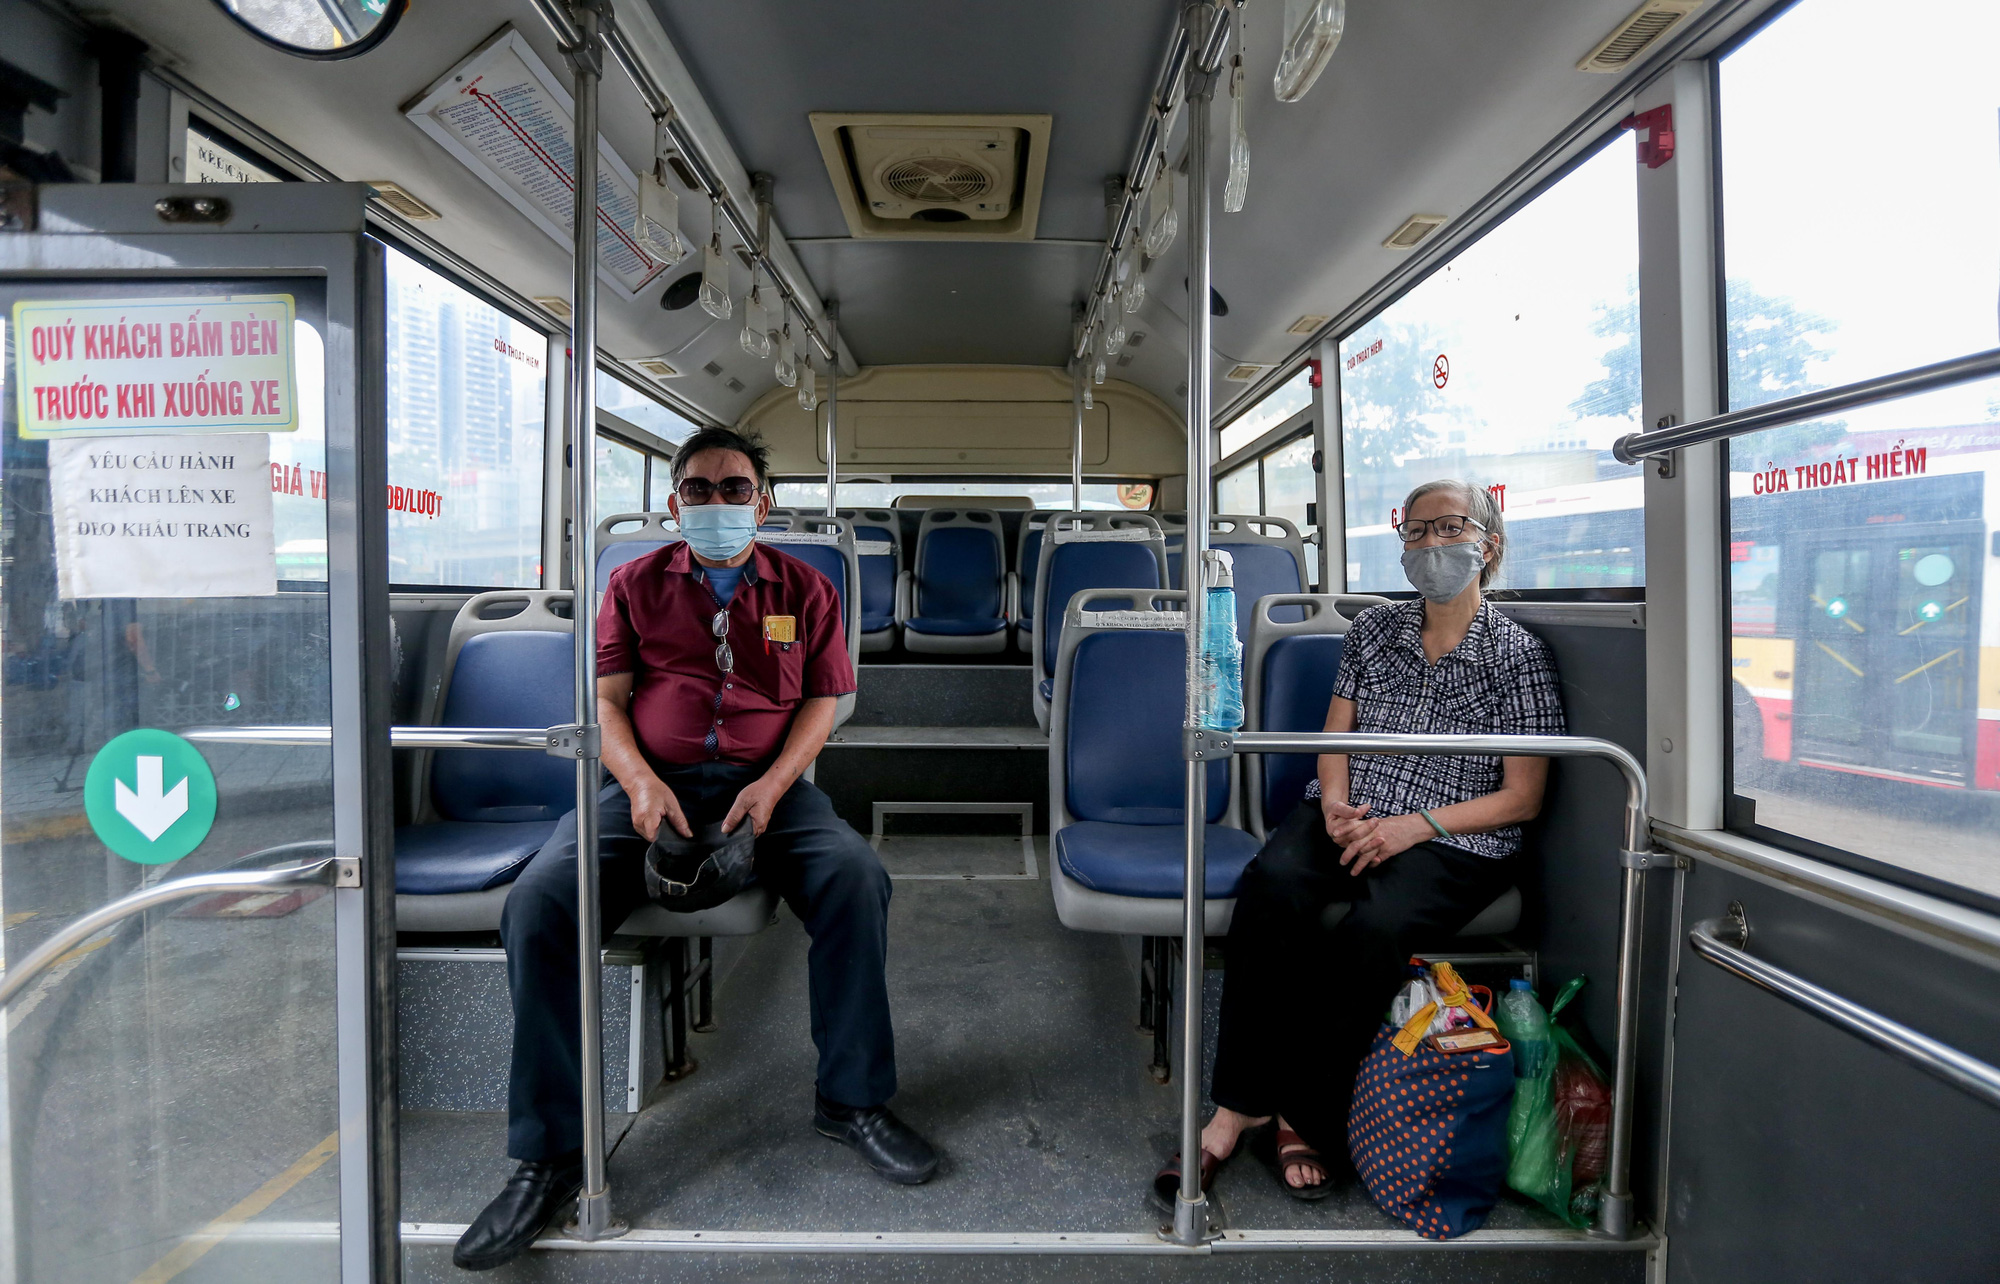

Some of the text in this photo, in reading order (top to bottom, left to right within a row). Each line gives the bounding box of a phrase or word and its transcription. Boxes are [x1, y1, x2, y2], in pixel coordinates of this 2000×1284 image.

[32, 309, 278, 365] QUÝ KHÁCH BẤM ĐÈN
[34, 369, 281, 420] TRƯỚC KHI XUỐNG XE
[89, 451, 127, 470] YÊU
[180, 452, 235, 470] HÀNH
[1753, 439, 1927, 495] CỬA THOÁT HIỂM
[90, 484, 236, 504] KHÁCH LÊN XE
[271, 462, 303, 497] GIÁ
[184, 523, 250, 538] TRANG
